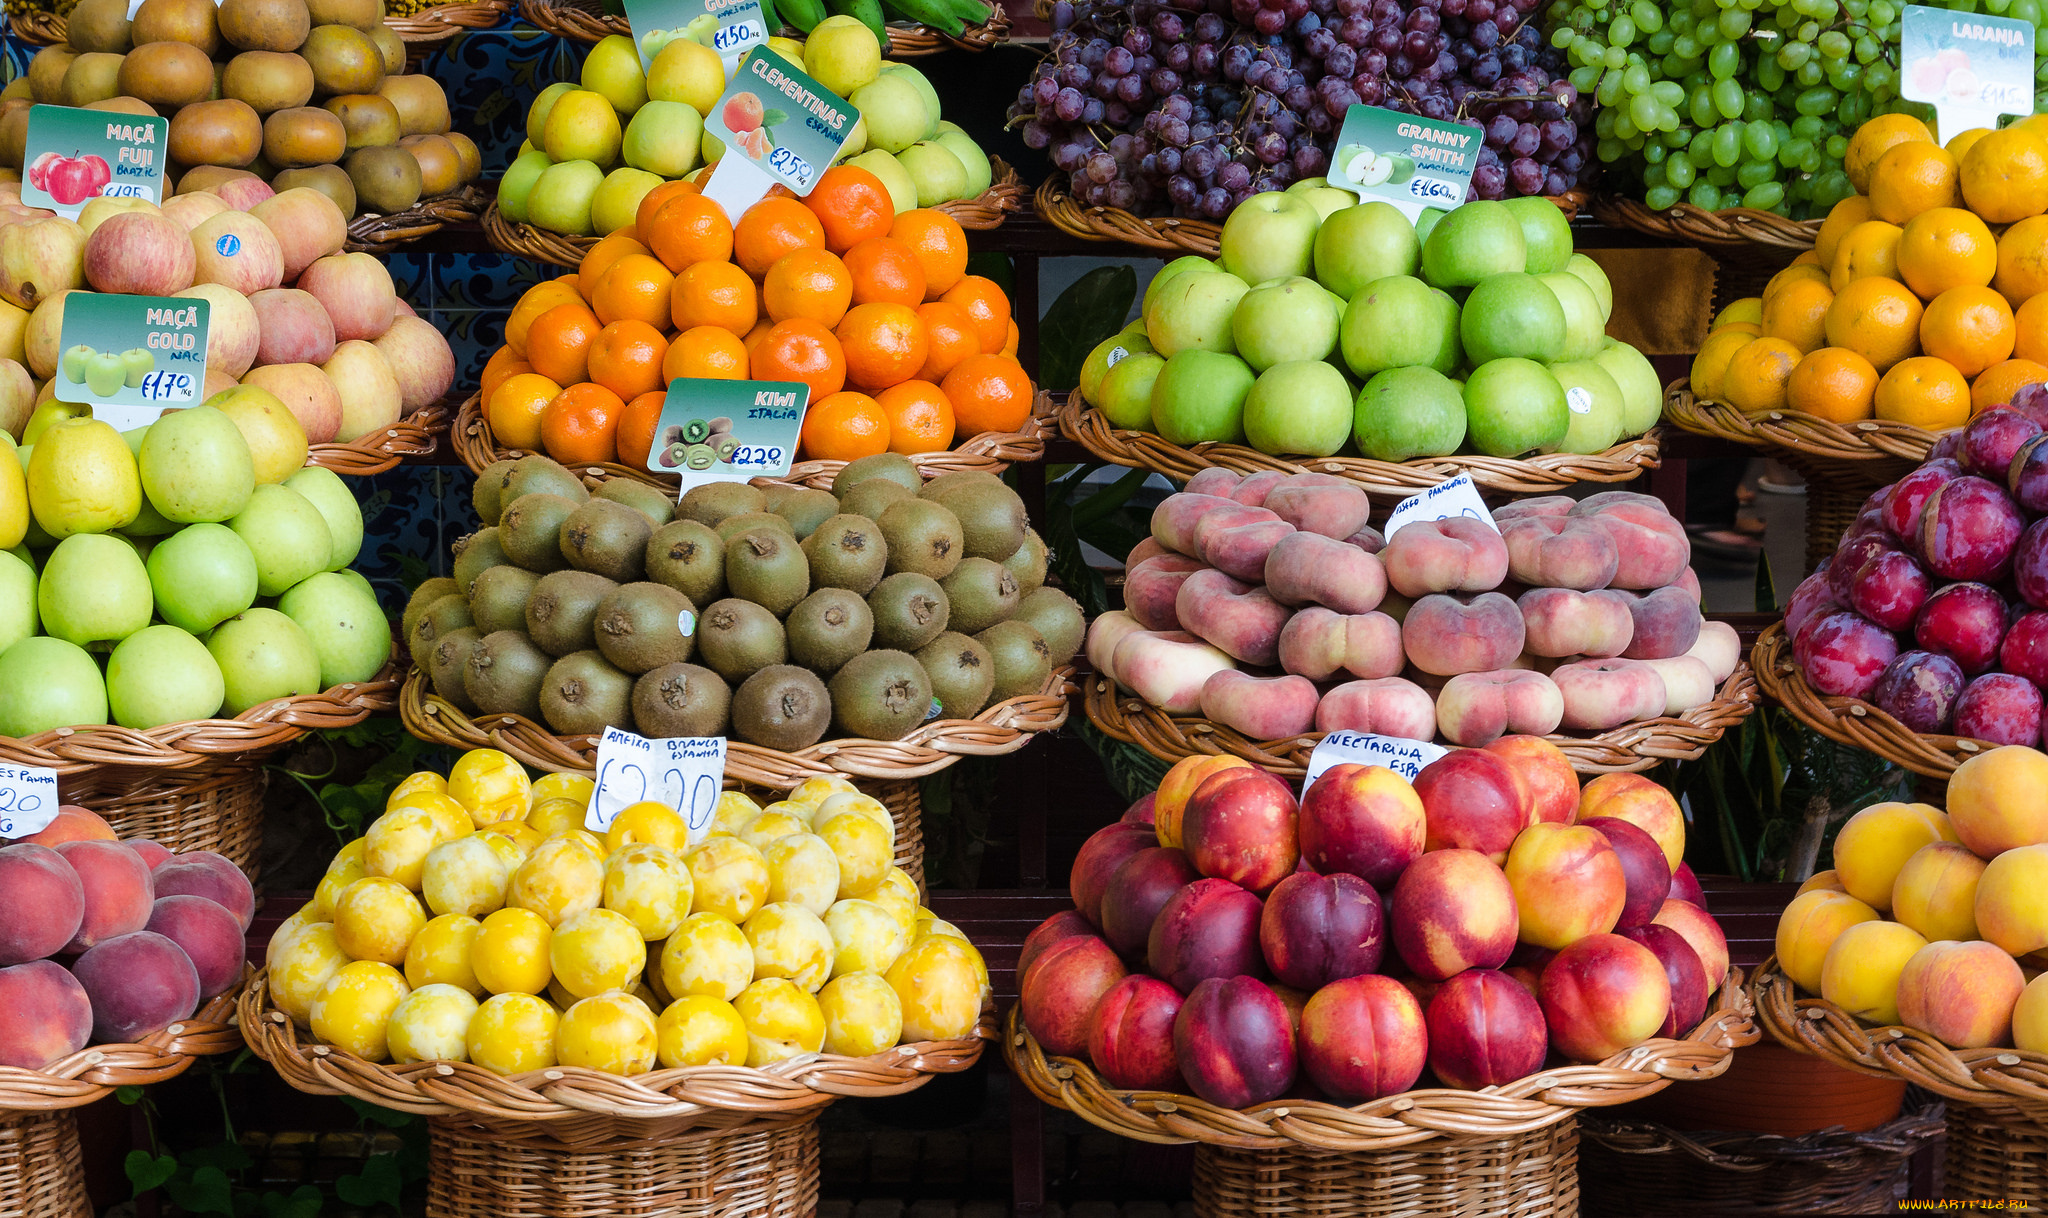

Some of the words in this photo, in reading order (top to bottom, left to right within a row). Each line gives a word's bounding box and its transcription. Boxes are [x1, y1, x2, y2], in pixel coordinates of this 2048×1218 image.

[705, 0, 745, 11] GO
[1952, 21, 2025, 47] LARANJA
[751, 58, 848, 130] CLEMENTINAS
[106, 123, 155, 145] MAÇÃ
[1397, 122, 1471, 149] GRANNY
[118, 147, 153, 168] FUJI
[1410, 143, 1465, 166] SMITH
[146, 306, 198, 330] MAÇÃ
[147, 332, 196, 351] GOLD
[141, 369, 190, 400] €1.70
[754, 391, 797, 407] KIWI
[730, 446, 782, 465] €2.20
[666, 739, 719, 751] BRANCA
